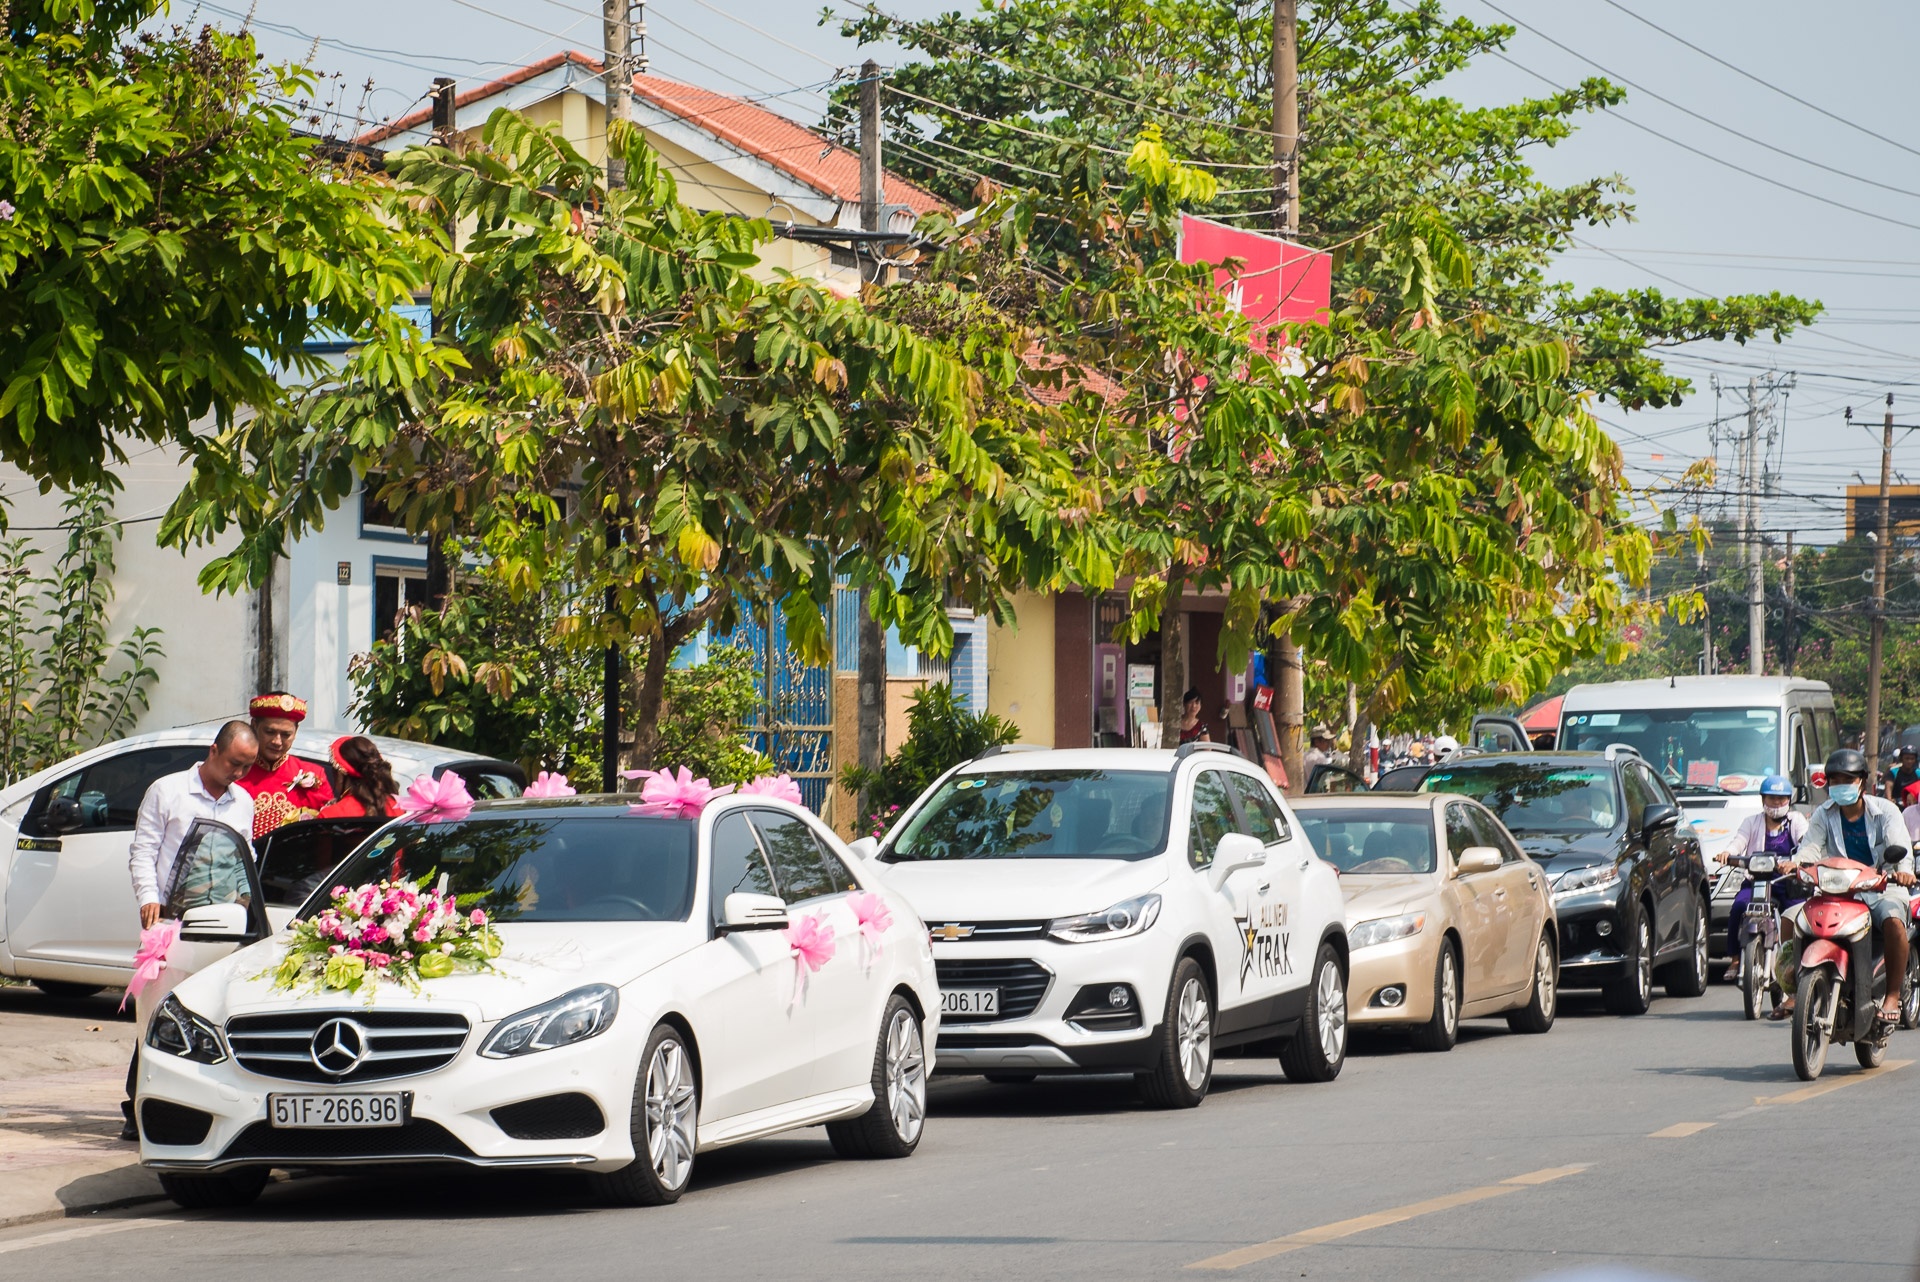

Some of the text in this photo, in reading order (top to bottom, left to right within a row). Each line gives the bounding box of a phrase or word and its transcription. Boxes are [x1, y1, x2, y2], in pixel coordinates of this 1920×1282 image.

[1261, 903, 1288, 928] ALL NEW
[1257, 932, 1293, 978] TRAX
[276, 1097, 397, 1124] 51F-266.96
